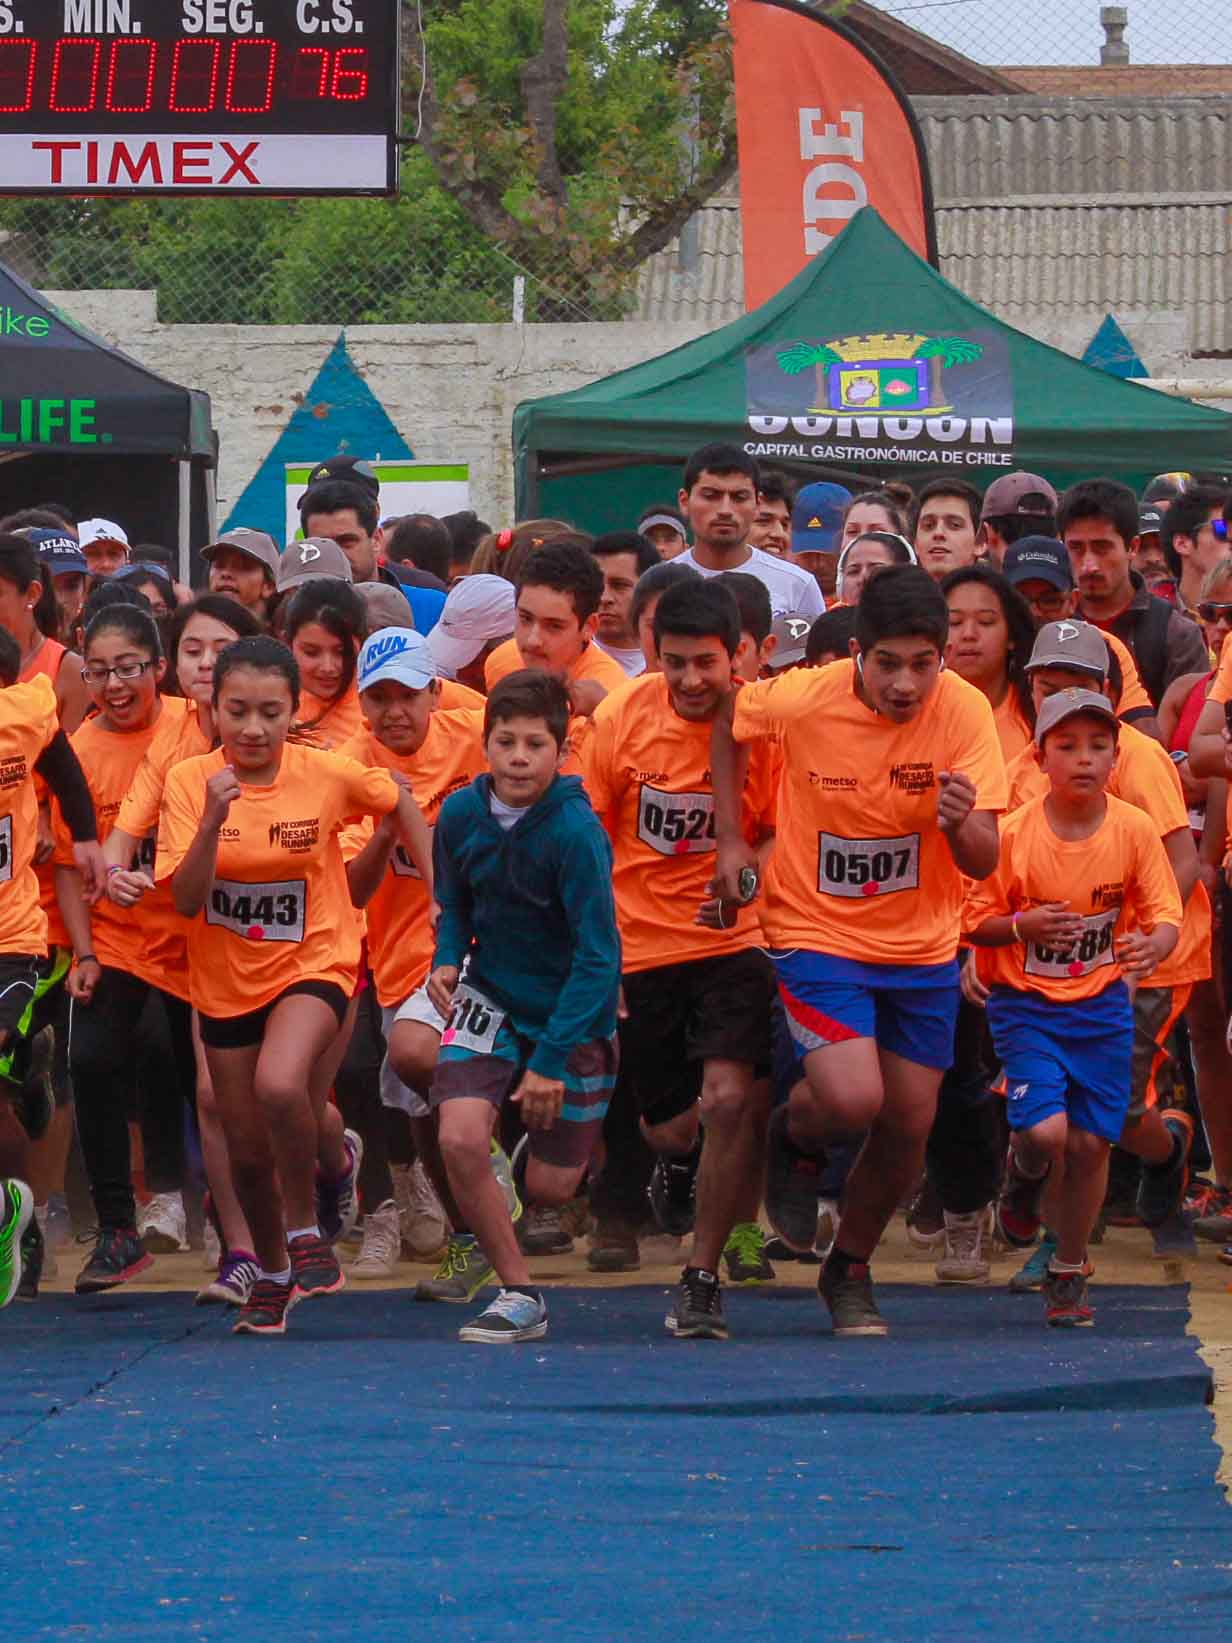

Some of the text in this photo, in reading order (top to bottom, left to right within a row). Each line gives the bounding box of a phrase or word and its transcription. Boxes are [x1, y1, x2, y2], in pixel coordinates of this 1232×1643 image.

[64, 0, 140, 33] MIN.
[182, 0, 263, 33] SEG.
[296, 0, 363, 33] C.S.
[300, 47, 368, 99] 76
[32, 141, 261, 184] TIMEX
[744, 442, 1013, 466] CAPITAL GASTRONÓMICA DE CHILE
[366, 636, 408, 664] RUN
[822, 777, 857, 786] metso
[825, 848, 911, 886] 0507
[211, 888, 298, 926] 0443
